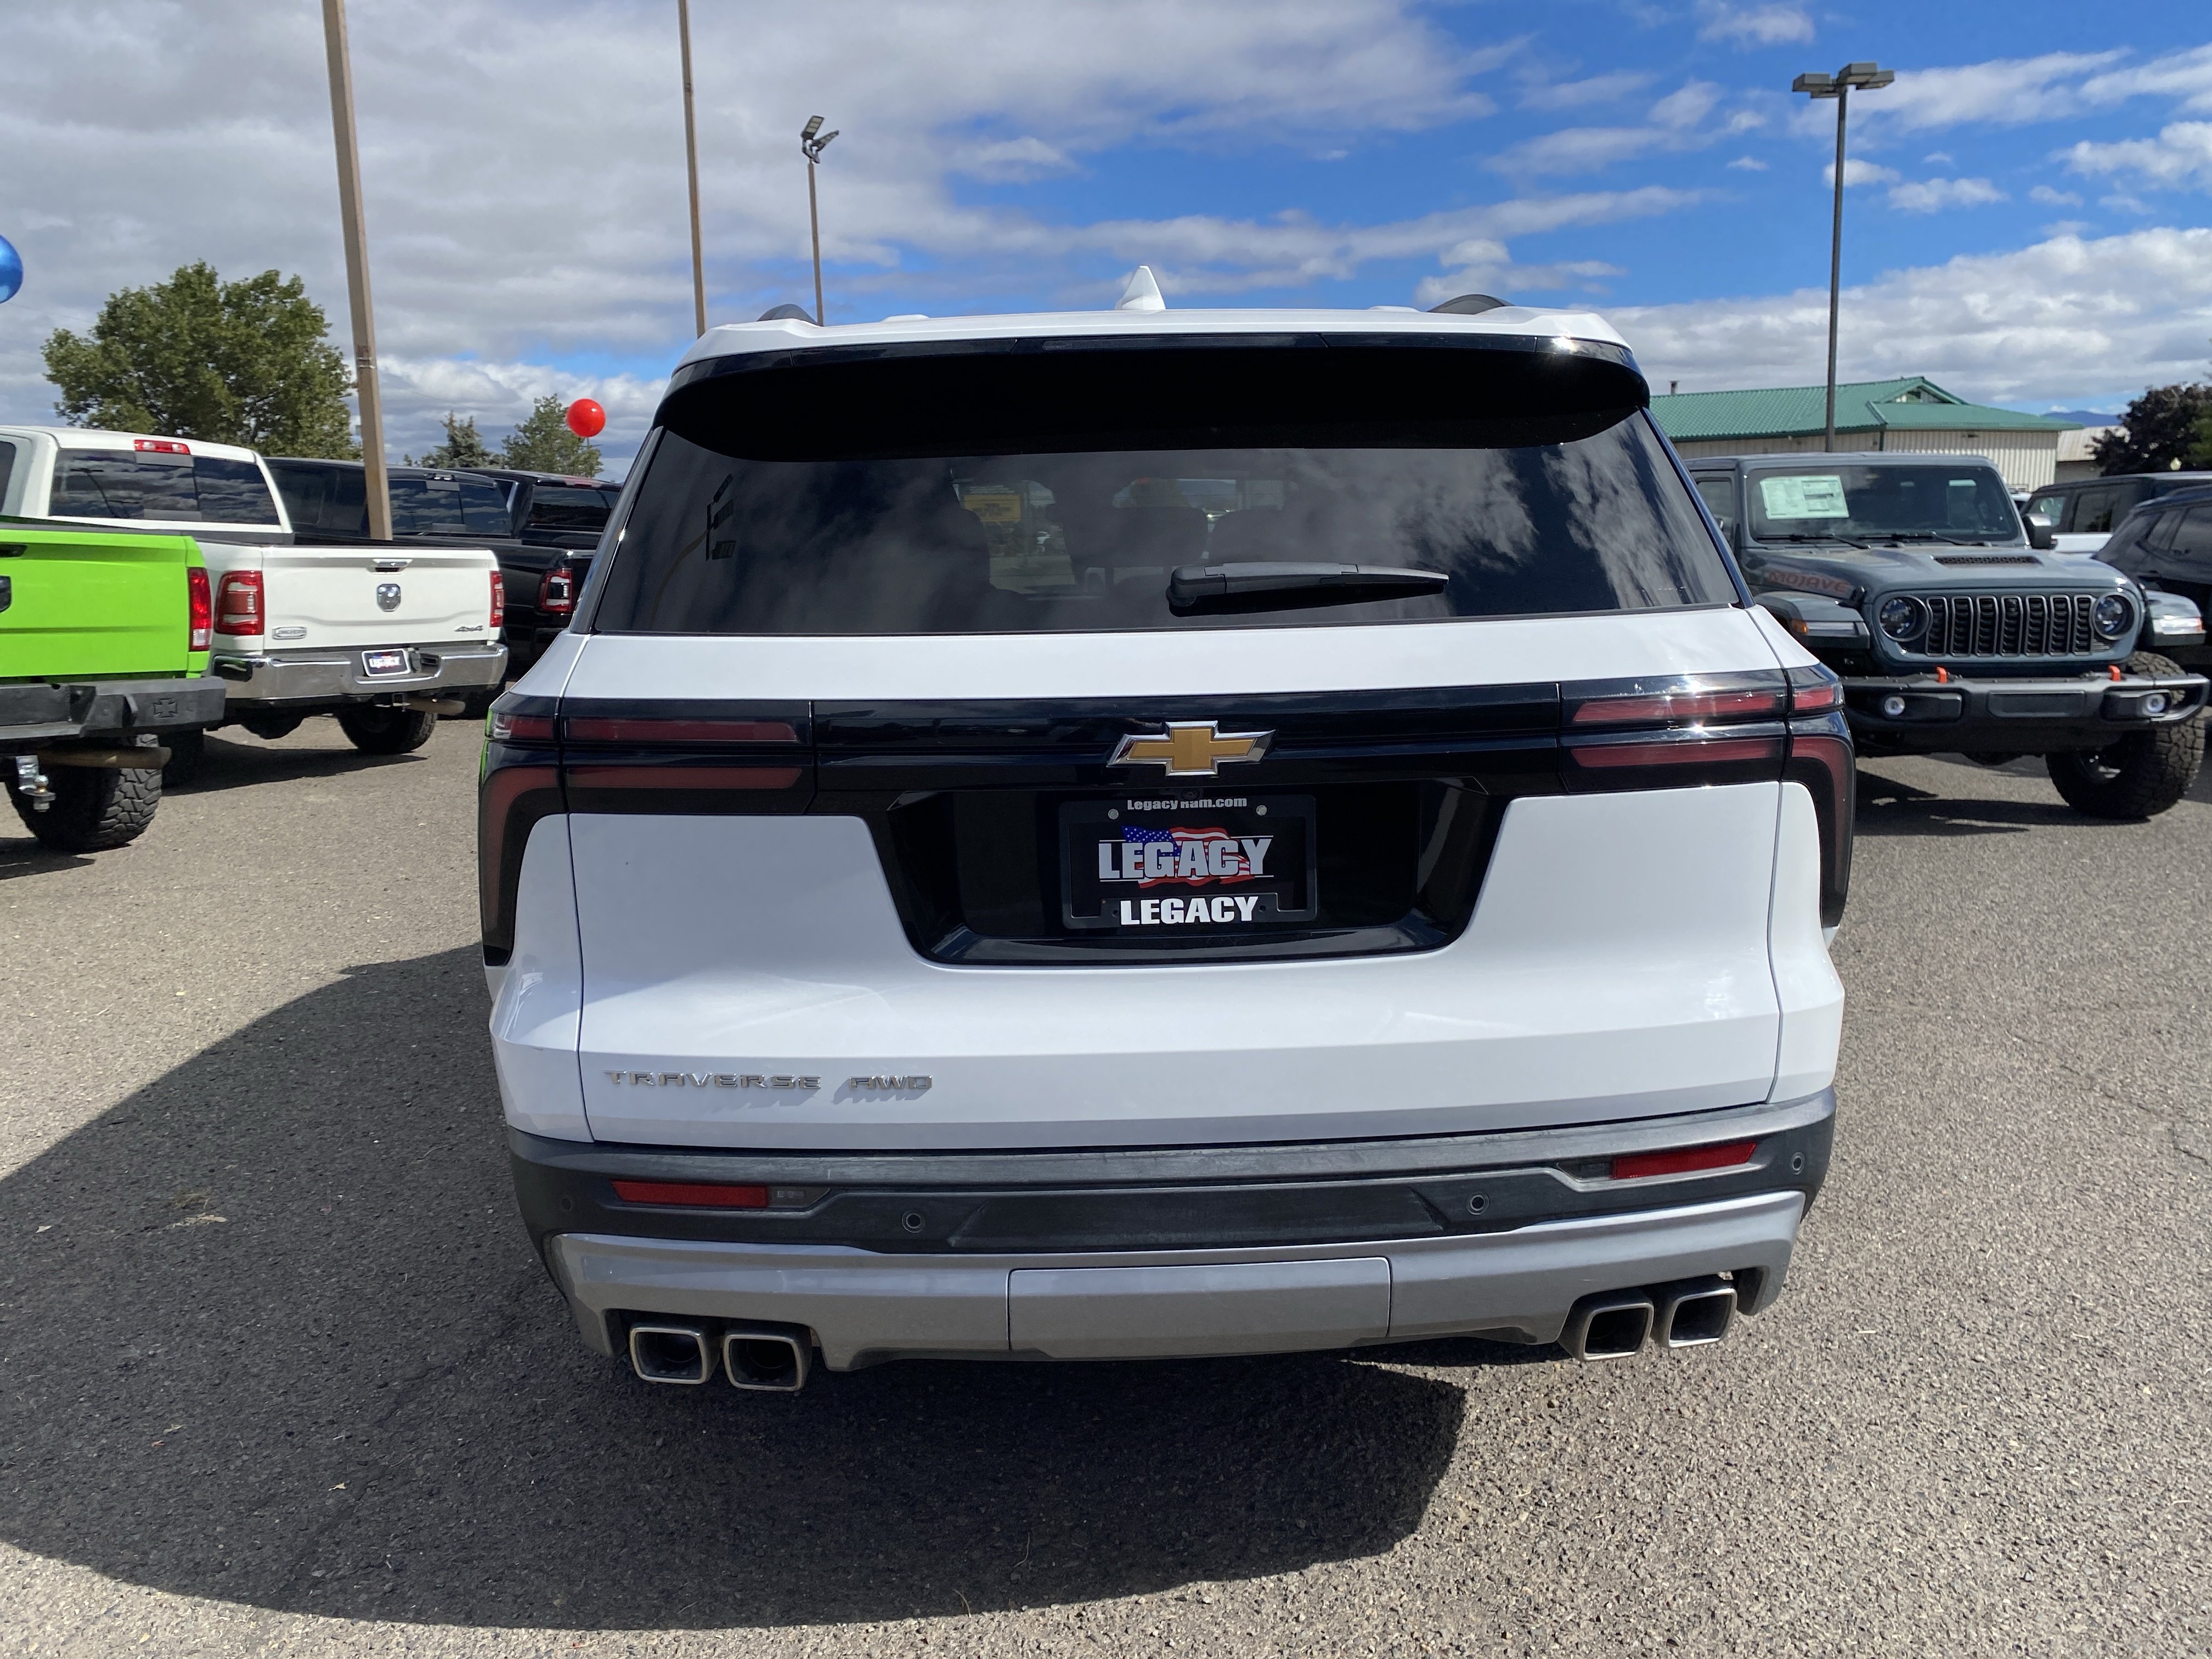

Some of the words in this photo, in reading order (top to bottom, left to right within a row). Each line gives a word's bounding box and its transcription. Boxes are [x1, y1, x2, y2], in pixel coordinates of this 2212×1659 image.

[1769, 571, 1849, 593] MOJAVE
[1099, 839, 1272, 879] LEGACY
[1120, 896, 1259, 925] LEGACY
[604, 1071, 821, 1089] TRAVERSE
[849, 1075, 933, 1090] AWD
